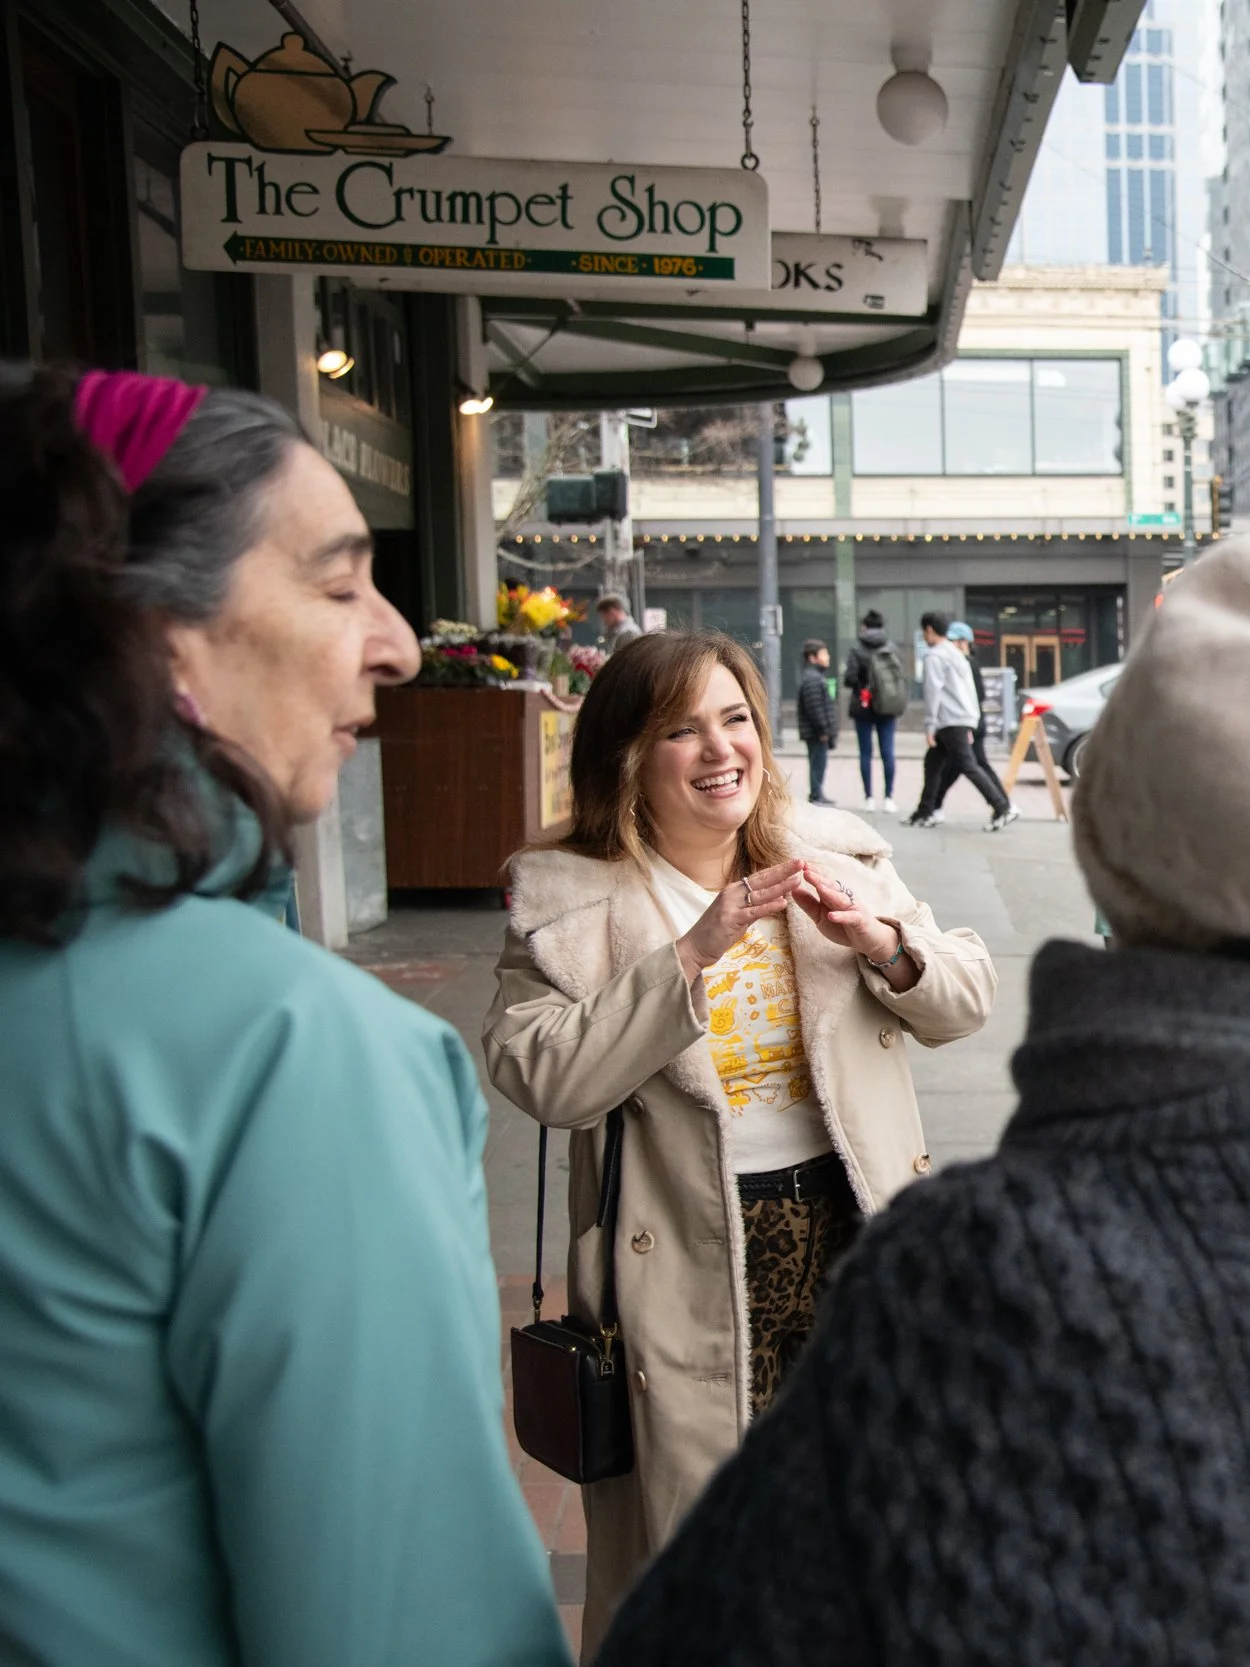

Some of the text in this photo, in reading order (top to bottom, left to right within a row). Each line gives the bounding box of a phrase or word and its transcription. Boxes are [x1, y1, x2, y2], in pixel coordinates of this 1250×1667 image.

[207, 152, 743, 253] The Crumpet Shop
[418, 246, 526, 270] OPERATED
[578, 253, 639, 274] SINCE
[653, 256, 697, 276] 1976
[772, 260, 844, 292] OKS
[773, 960, 796, 979] PU
[760, 978, 798, 1000] MAR
